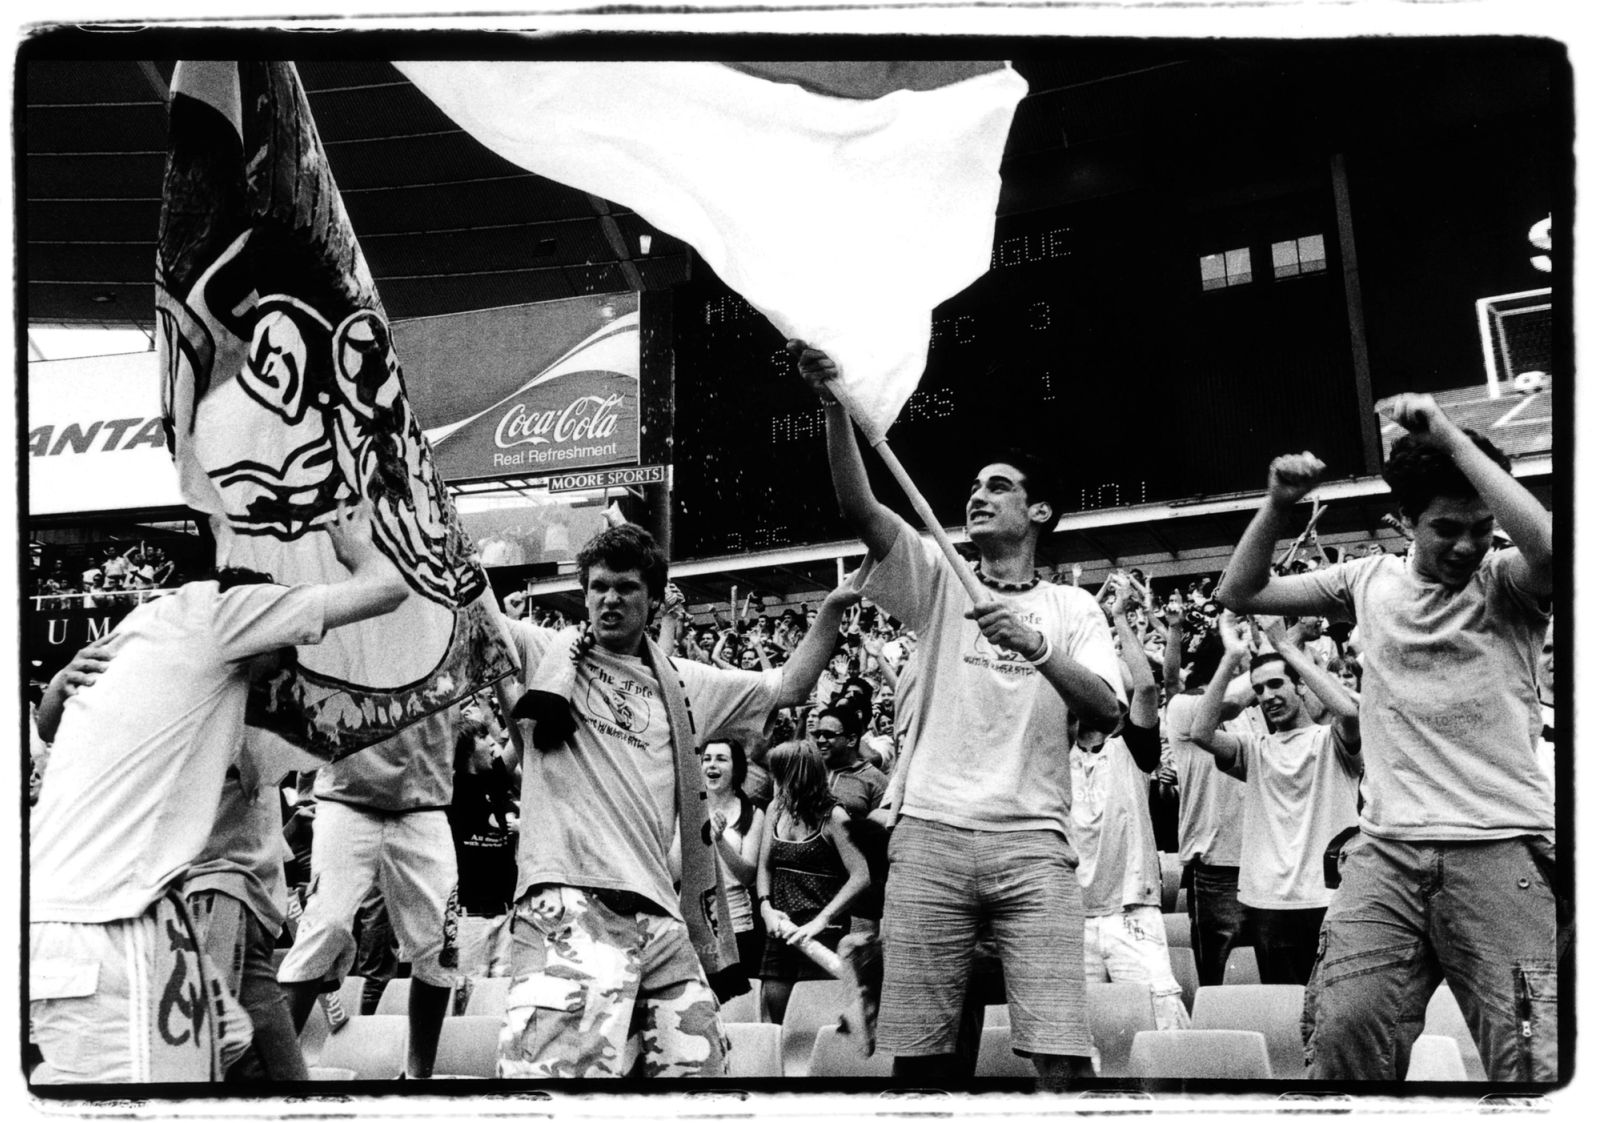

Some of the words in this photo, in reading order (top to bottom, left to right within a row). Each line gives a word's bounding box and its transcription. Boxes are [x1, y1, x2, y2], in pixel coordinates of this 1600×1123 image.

[1028, 301, 1051, 331] 3
[1042, 371, 1056, 401] 1
[493, 452, 524, 467] Real
[528, 443, 617, 463] Refreshment
[551, 474, 605, 490] MOORE
[608, 468, 660, 485] SPORTS
